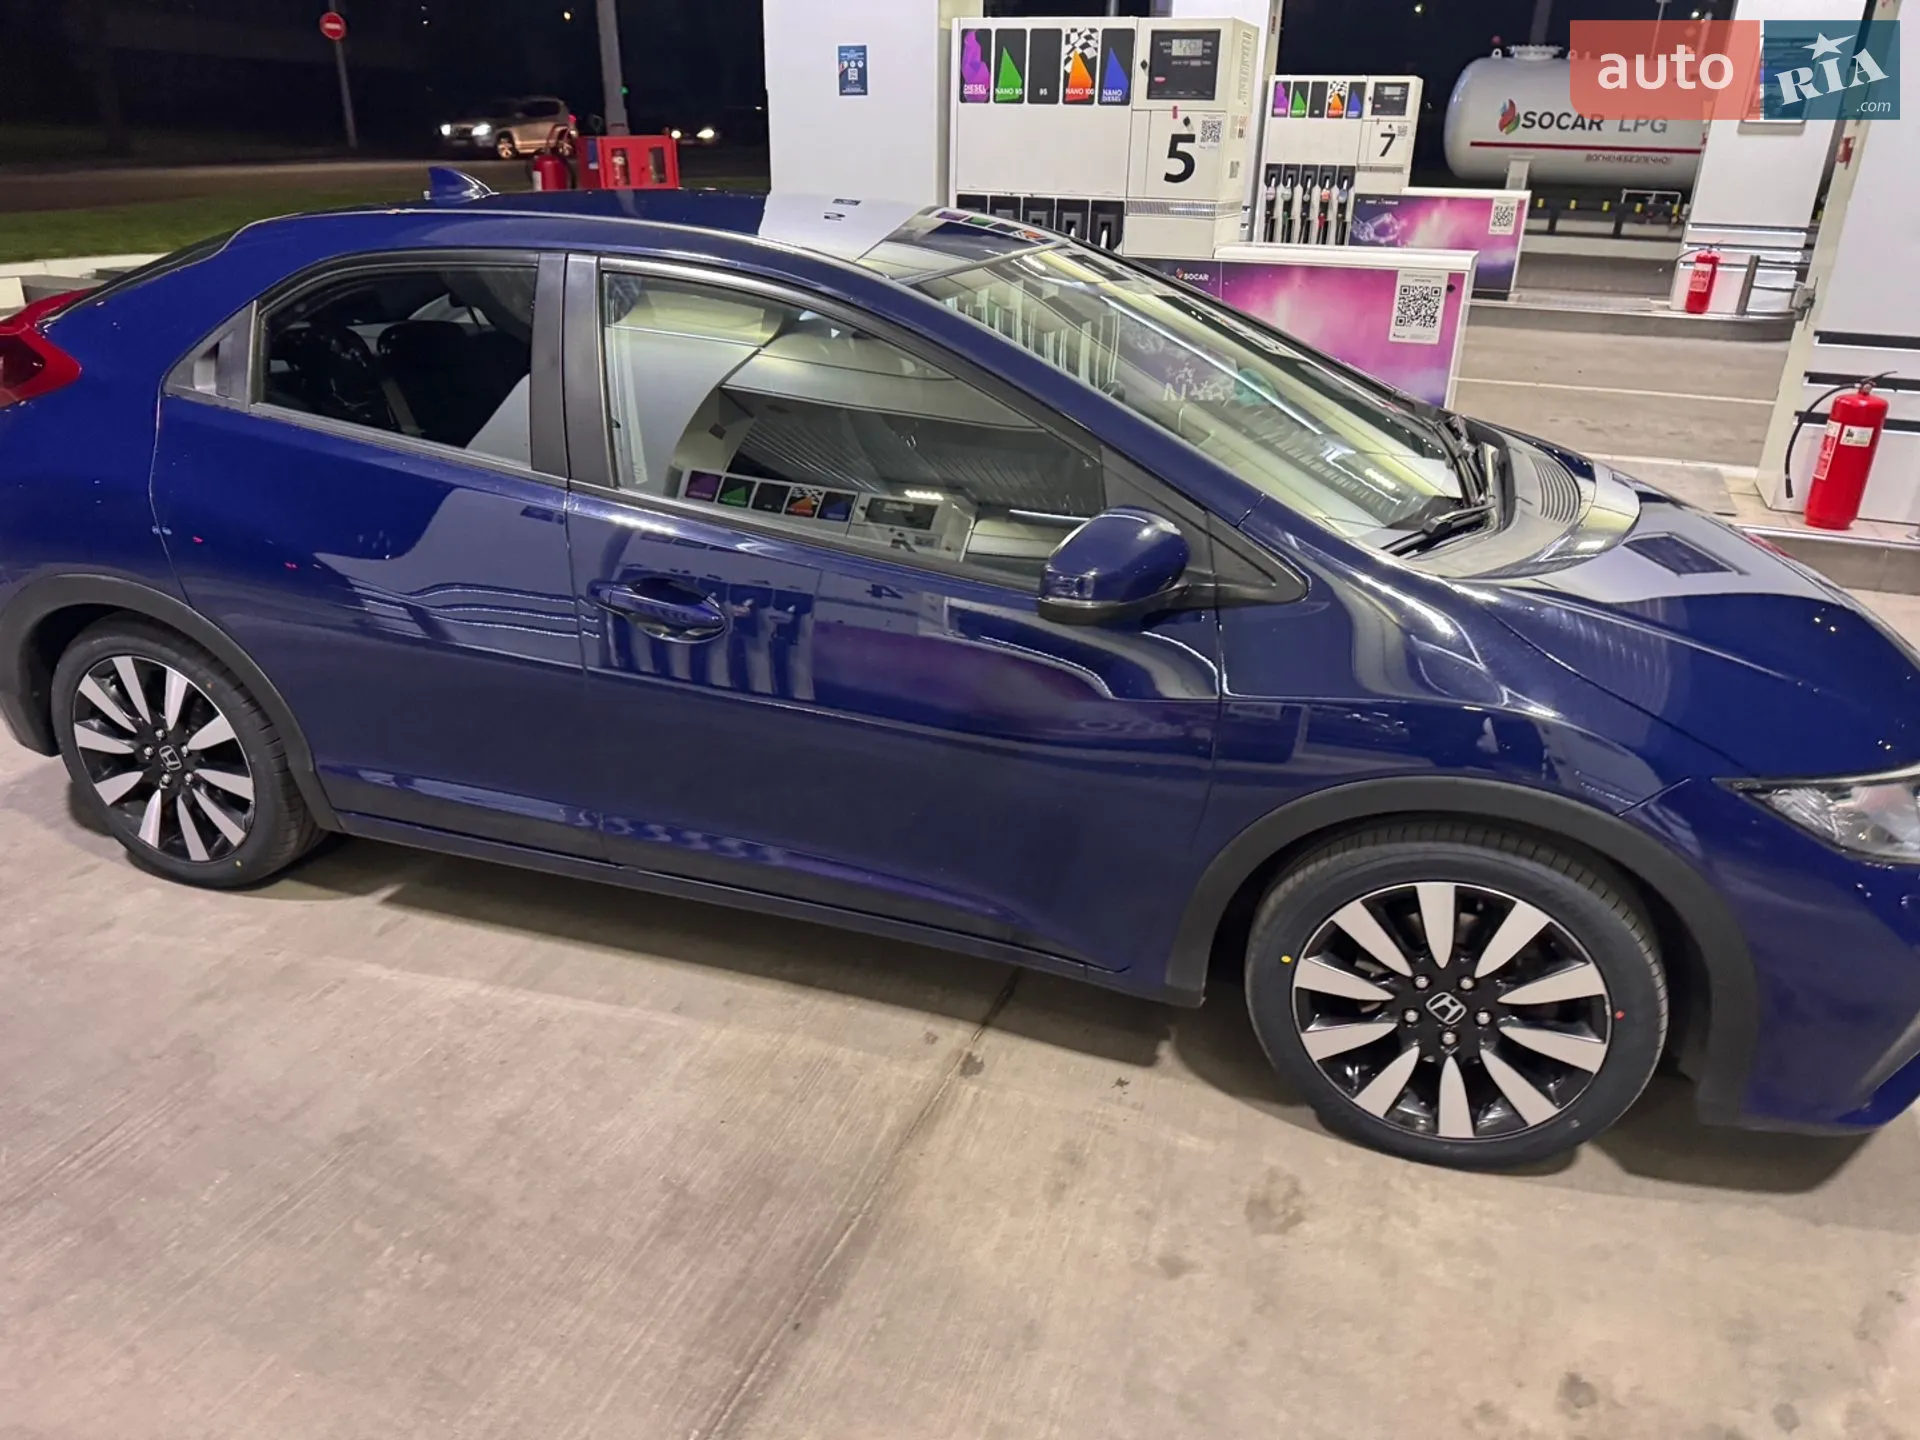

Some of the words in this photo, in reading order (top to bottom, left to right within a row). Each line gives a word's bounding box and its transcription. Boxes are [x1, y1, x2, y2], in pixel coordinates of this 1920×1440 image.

[1102, 88, 1123, 96] NANO
[1521, 110, 1604, 132] SOCAR
[1617, 113, 1669, 134] LPG
[1379, 132, 1396, 157] 7
[1163, 133, 1196, 184] 5
